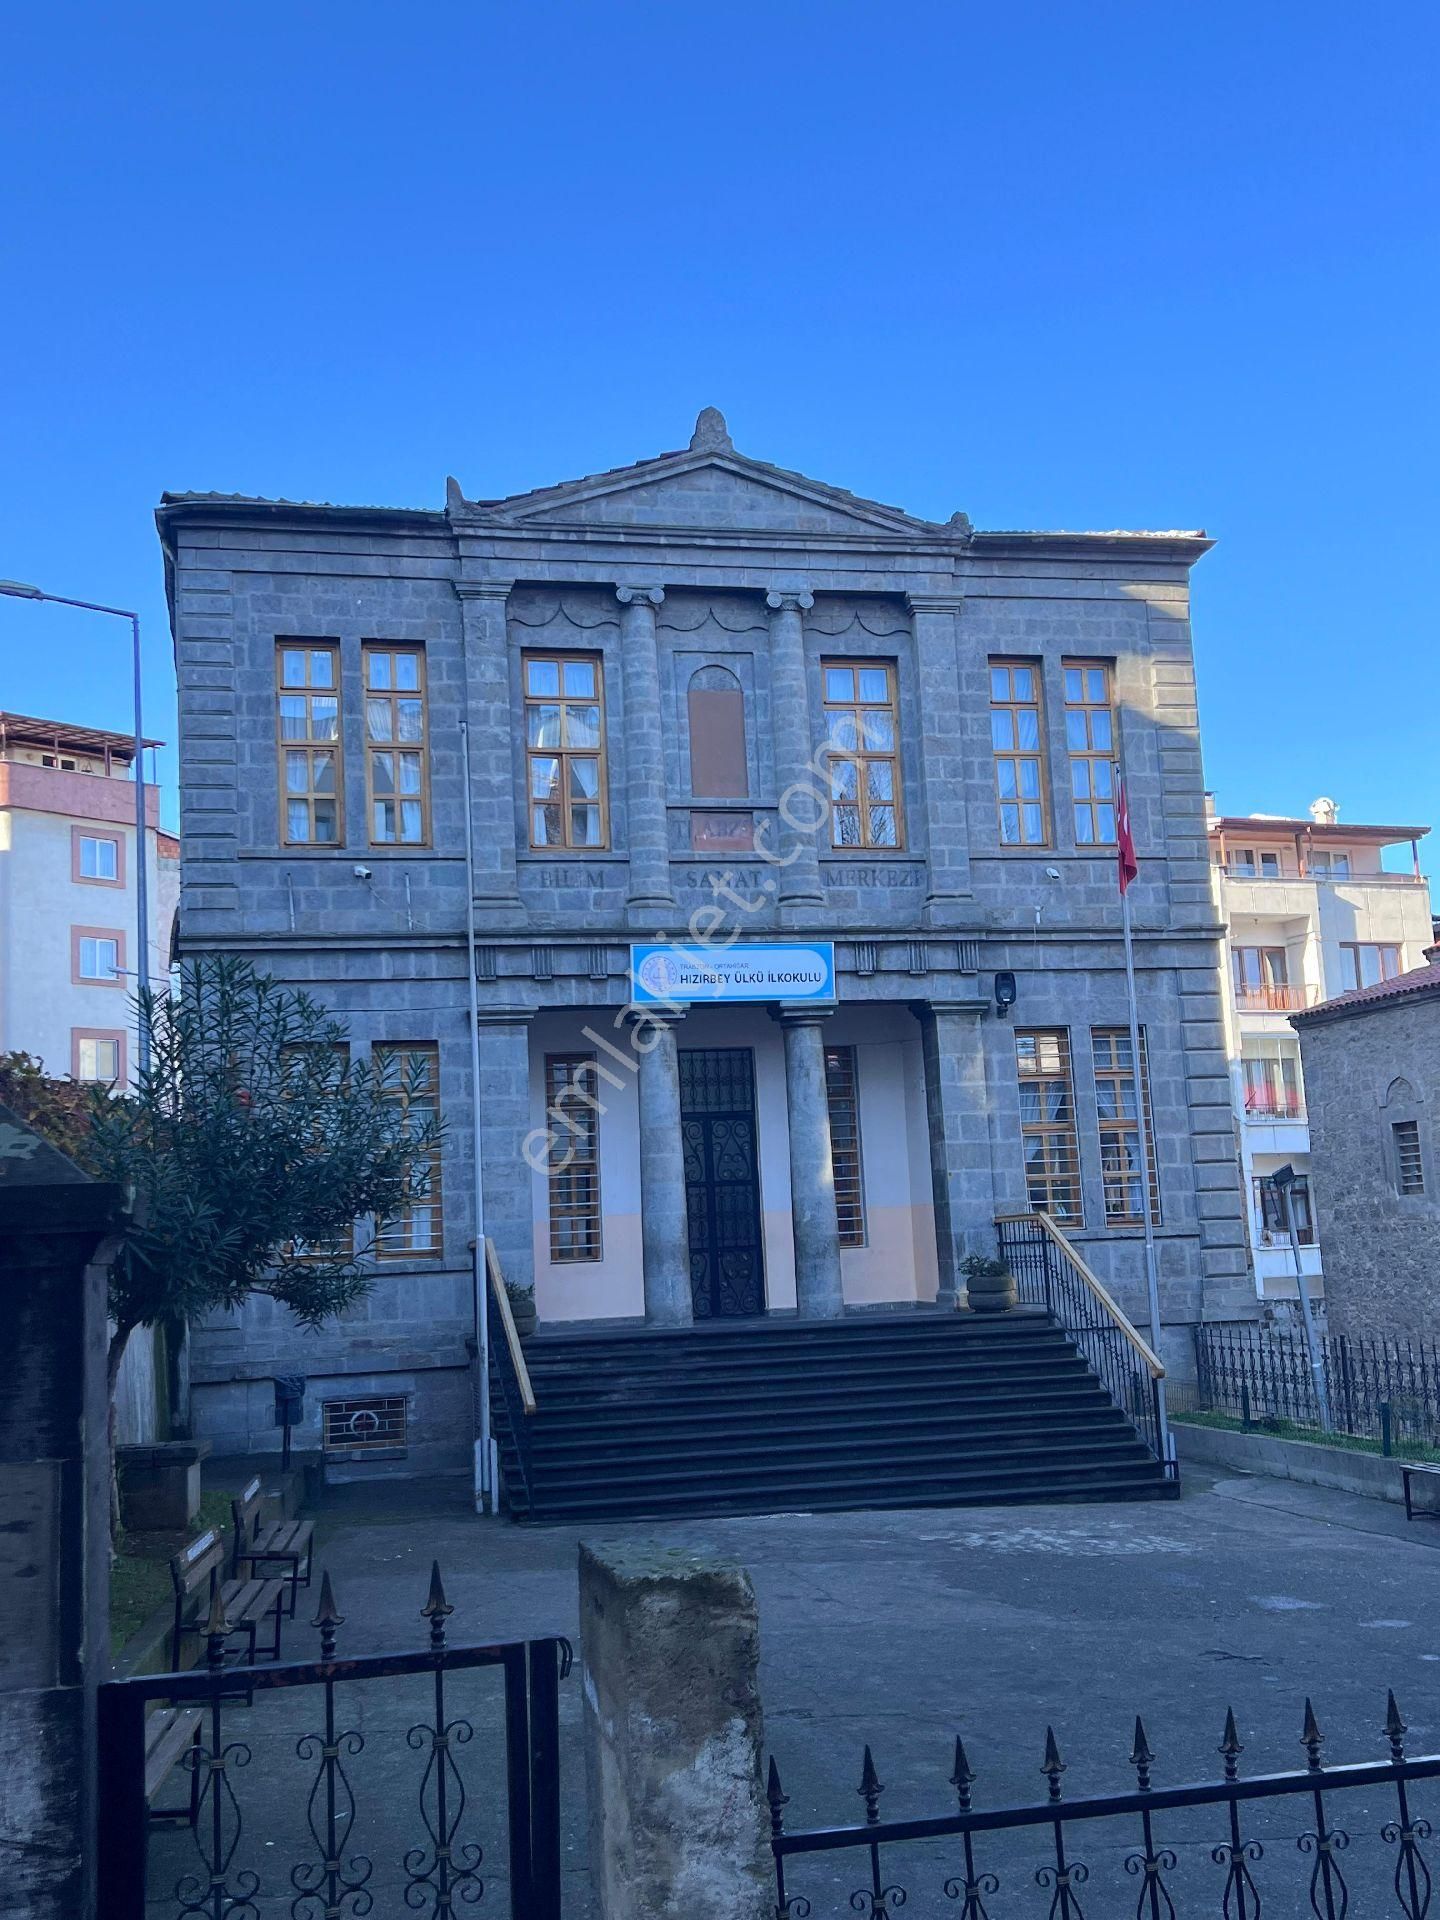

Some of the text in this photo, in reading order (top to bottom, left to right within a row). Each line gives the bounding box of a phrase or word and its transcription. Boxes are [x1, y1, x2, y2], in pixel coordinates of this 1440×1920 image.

[680, 970, 822, 984] HIZIRBEY ÜLKÜ İLKOKULU
